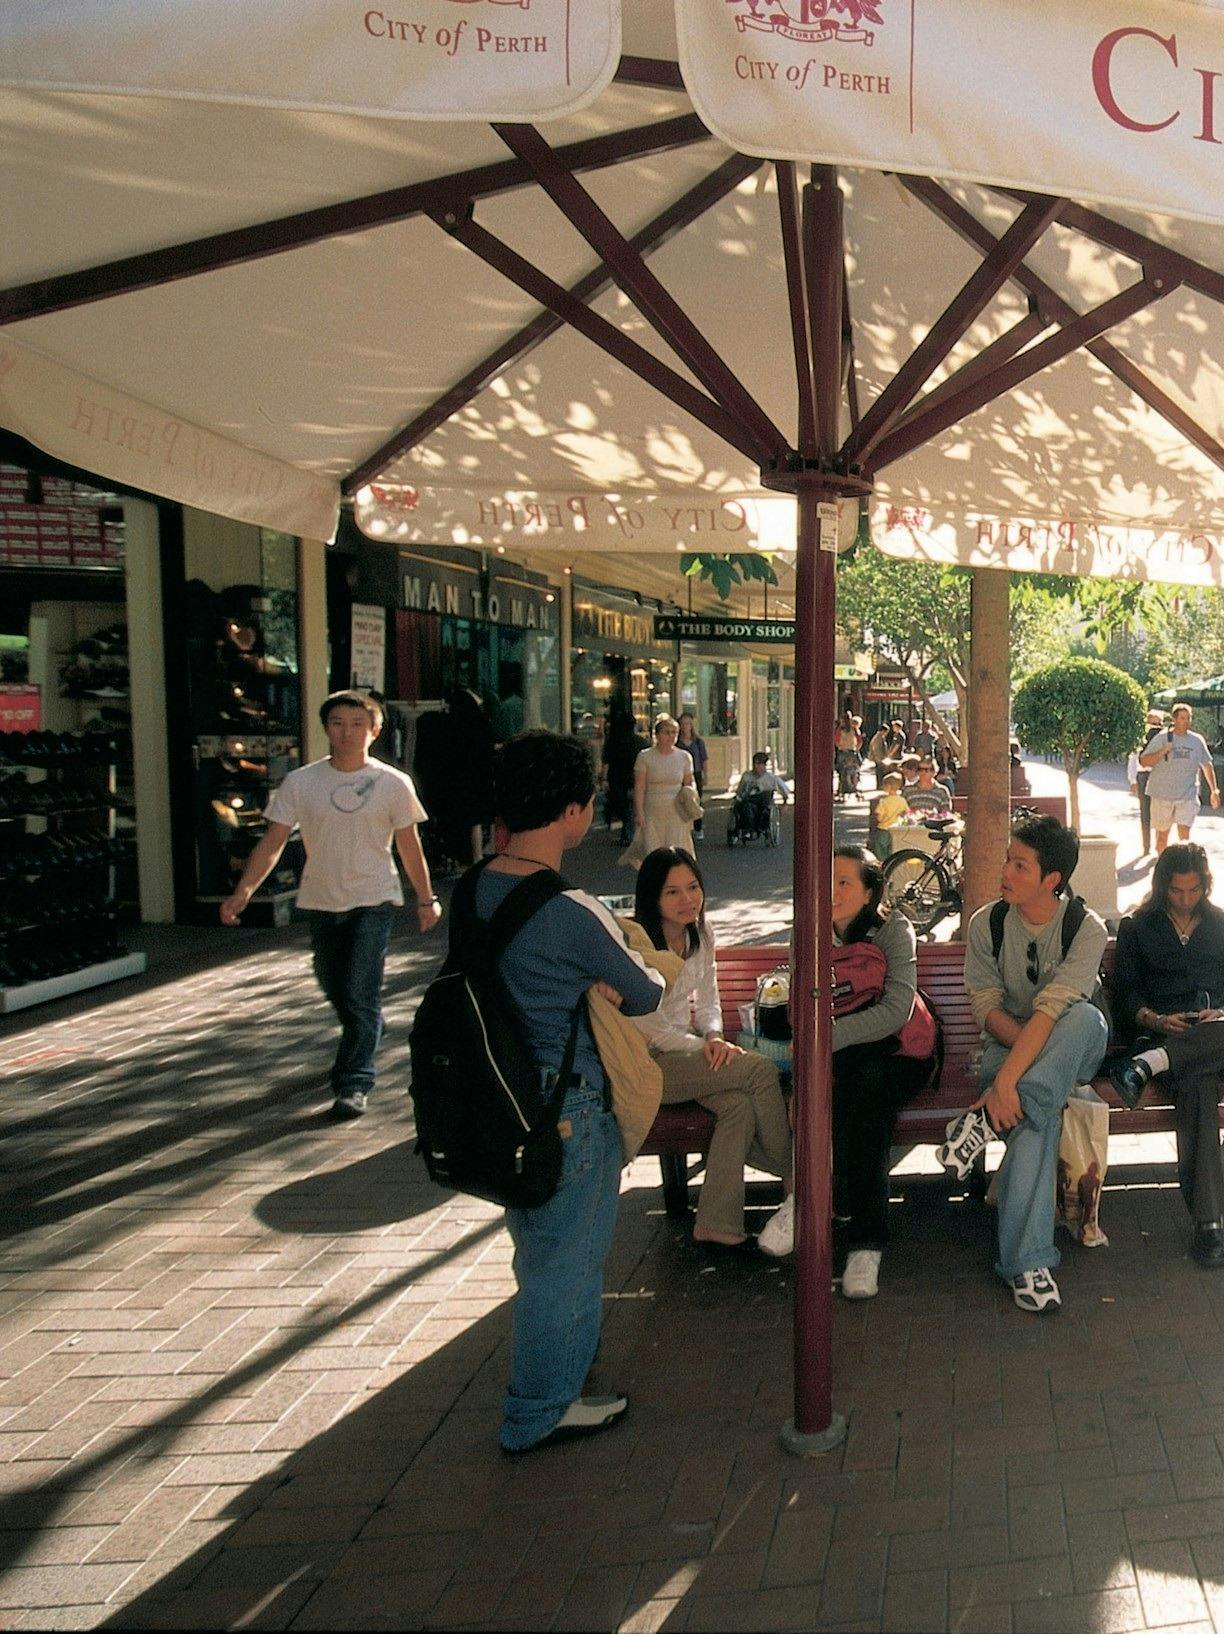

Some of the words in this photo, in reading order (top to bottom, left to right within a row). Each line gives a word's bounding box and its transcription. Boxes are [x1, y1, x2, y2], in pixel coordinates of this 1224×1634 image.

[435, 20, 468, 56] of
[783, 28, 827, 39] FLOREAT
[786, 59, 816, 91] of
[404, 575, 459, 615] MAN
[471, 591, 500, 622] TO
[511, 600, 549, 630] MAN
[678, 622, 711, 635] THE
[715, 624, 754, 637] BODY
[756, 625, 795, 638] SHOP
